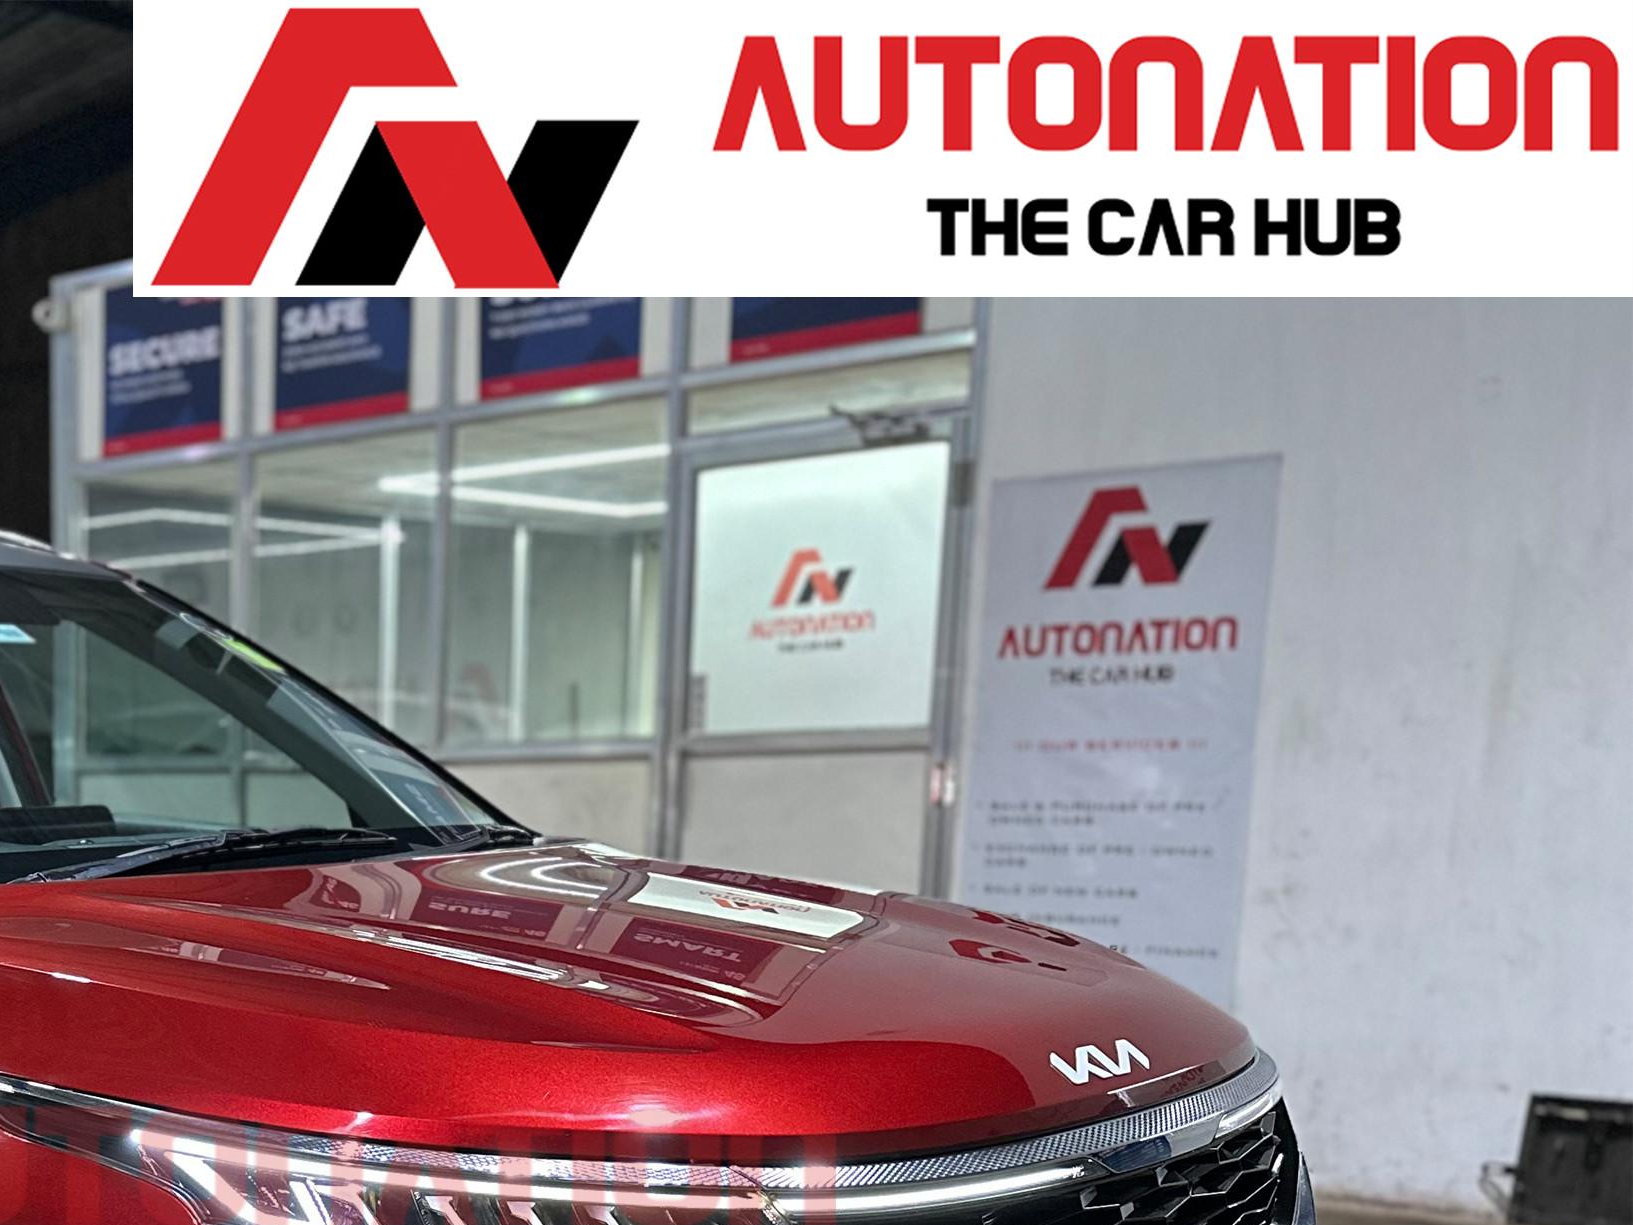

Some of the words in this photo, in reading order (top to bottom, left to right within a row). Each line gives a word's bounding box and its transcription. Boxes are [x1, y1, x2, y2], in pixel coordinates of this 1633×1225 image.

[280, 297, 368, 342] SAFE
[107, 324, 221, 377] SECURE
[998, 615, 1239, 660] AUTONATION
[1049, 666, 1084, 686] THE
[1089, 664, 1129, 685] CAR
